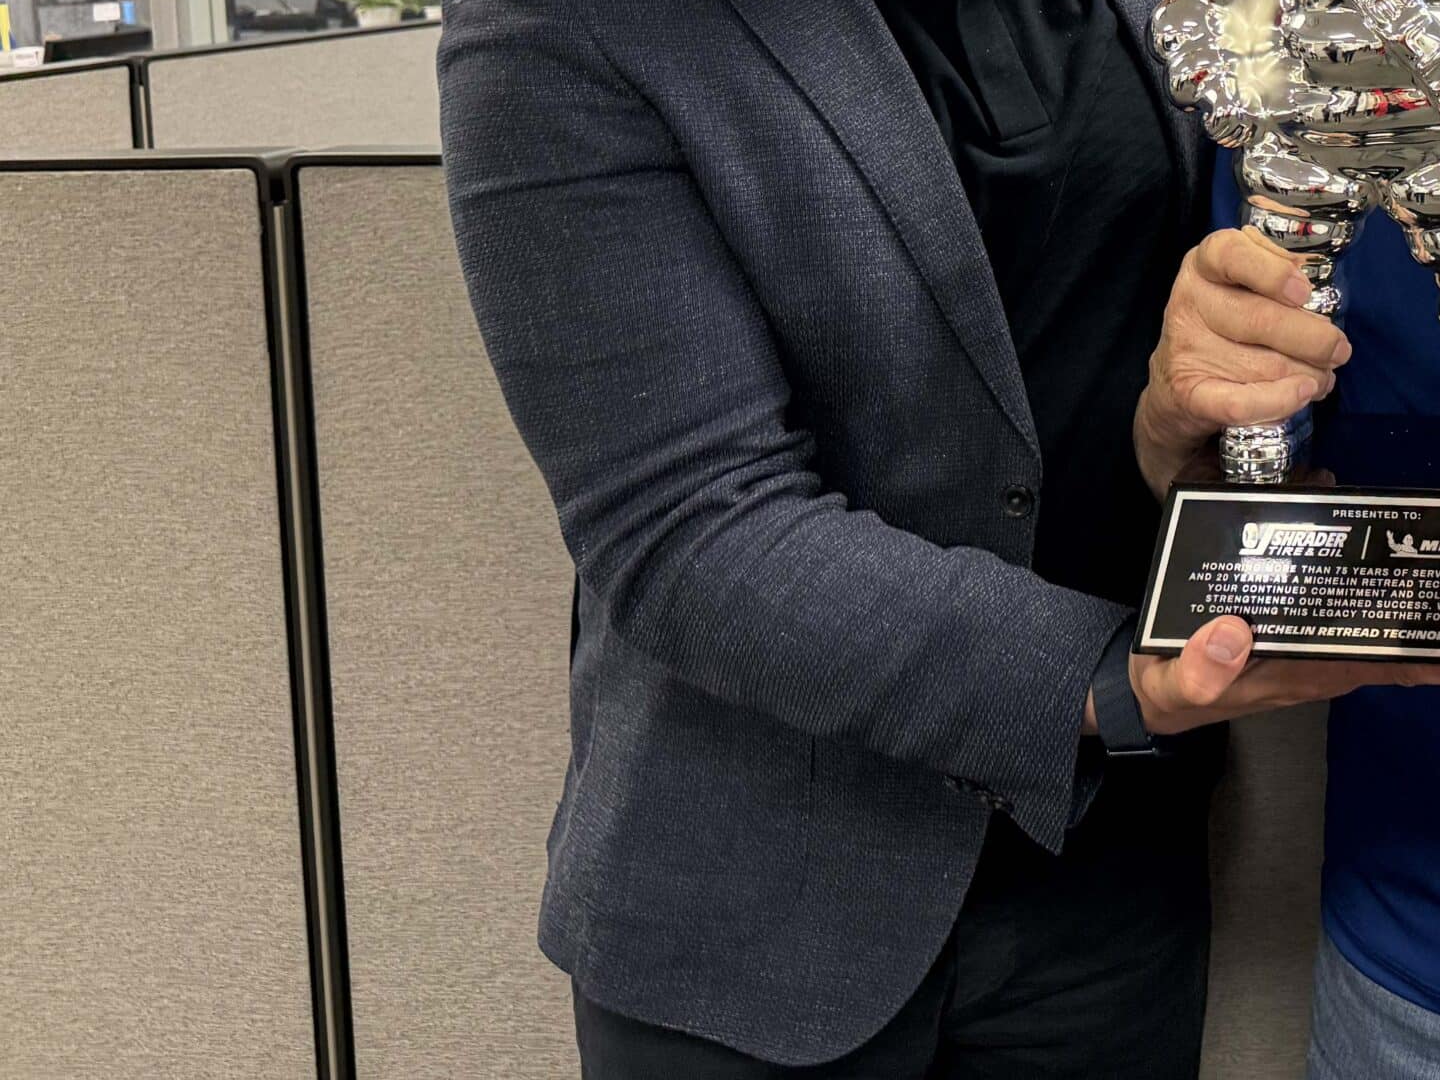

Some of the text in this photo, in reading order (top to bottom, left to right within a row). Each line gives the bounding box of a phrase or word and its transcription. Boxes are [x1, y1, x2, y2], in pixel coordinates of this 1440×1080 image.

[1333, 509, 1421, 520] PRESENTED TO:
[1271, 530, 1348, 548] SHRADER
[1268, 547, 1344, 558] TIRE & OIL
[1202, 562, 1261, 573] HONORING
[1301, 565, 1332, 575] THAN
[1336, 566, 1348, 575] 75
[1353, 567, 1390, 577] YEARS
[1393, 567, 1409, 577] OF
[1189, 572, 1212, 582] AND
[1216, 573, 1229, 582] 20
[1234, 573, 1270, 583] YEARS
[1291, 575, 1300, 585] A
[1304, 575, 1358, 586] MICHELIN
[1361, 578, 1414, 589] RETREAD
[1208, 583, 1238, 593] YOUR
[1242, 584, 1307, 595] CONTINUED
[1311, 586, 1387, 598] COMMITMENT
[1390, 589, 1414, 599] AND
[1205, 594, 1295, 606] STRENGTHENED
[1299, 597, 1323, 607] OUR
[1327, 598, 1372, 608] SHARED
[1376, 600, 1432, 611] SUCCESS.
[1190, 603, 1205, 613] TO
[1209, 604, 1279, 616] CONTINUING
[1283, 607, 1308, 617] THIS
[1313, 608, 1358, 618] LEGACY
[1362, 610, 1422, 621] TOGETHER
[1251, 623, 1316, 636] MICHELIN
[1318, 626, 1380, 638] RETREAD
